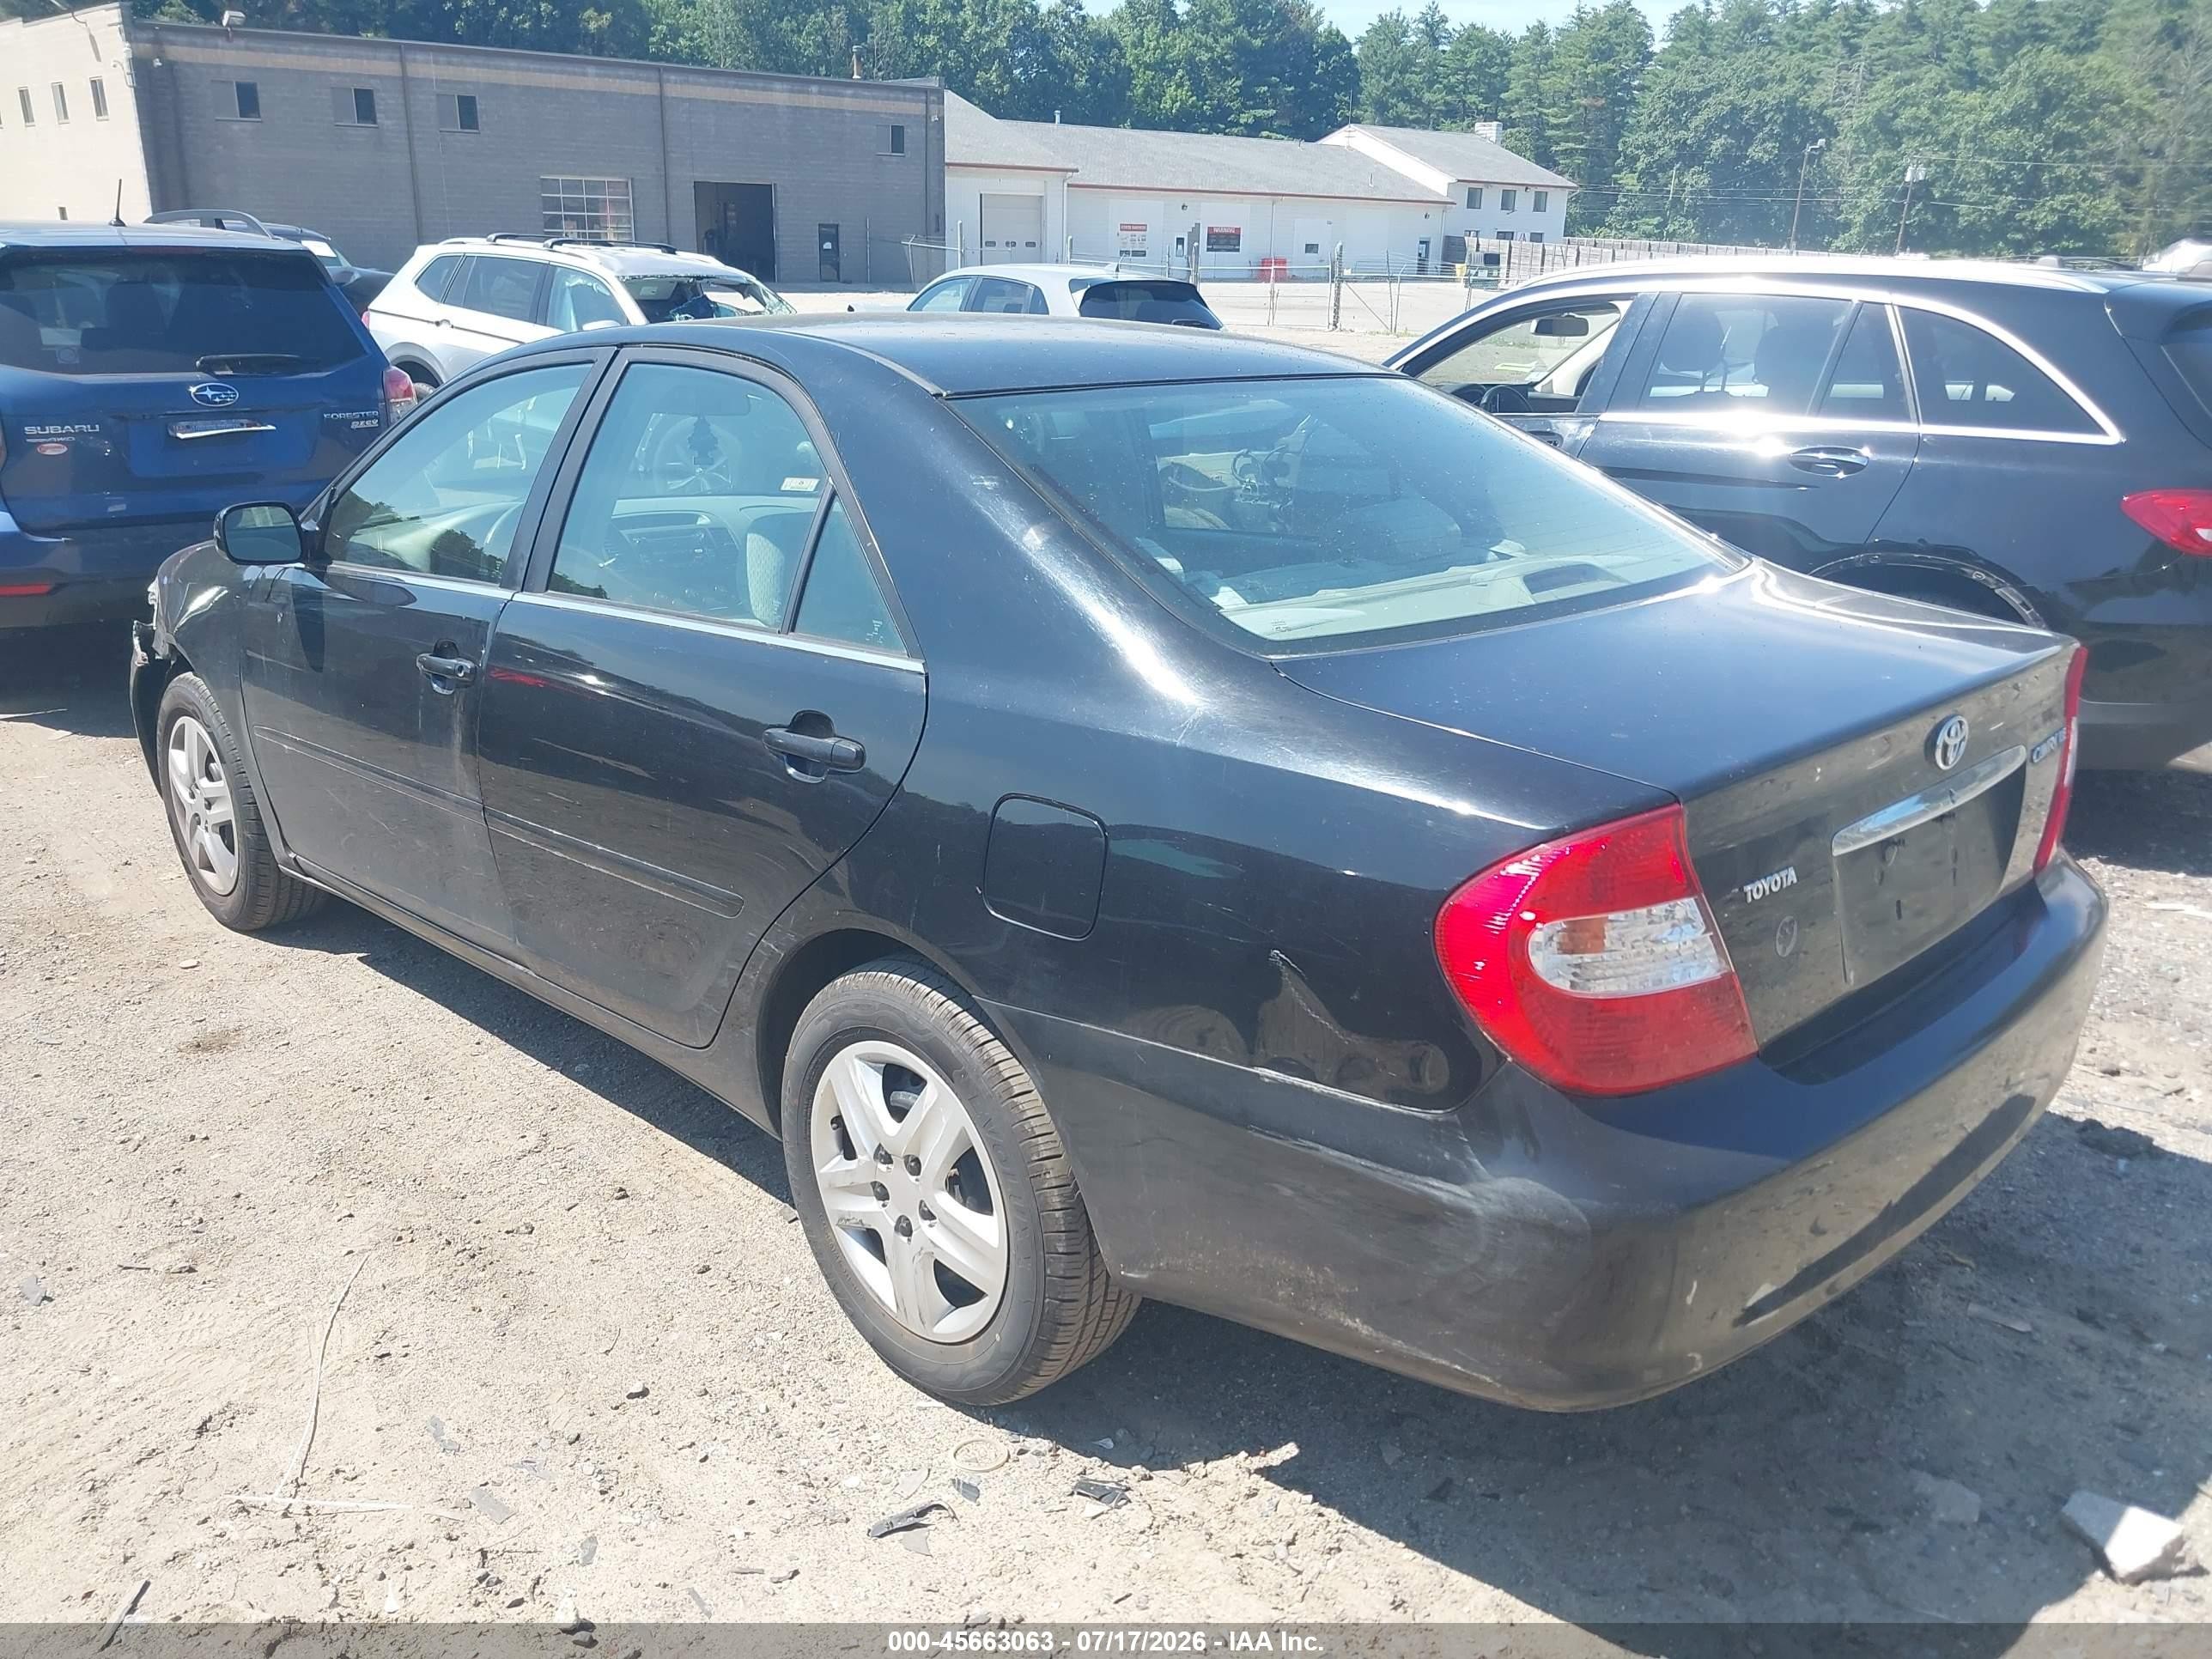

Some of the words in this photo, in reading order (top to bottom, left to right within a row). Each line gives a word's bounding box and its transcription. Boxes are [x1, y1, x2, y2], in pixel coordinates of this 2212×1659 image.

[323, 410, 379, 420] FORESTER
[24, 424, 100, 434] SUBARU
[1743, 866, 1797, 903] TOYOTA
